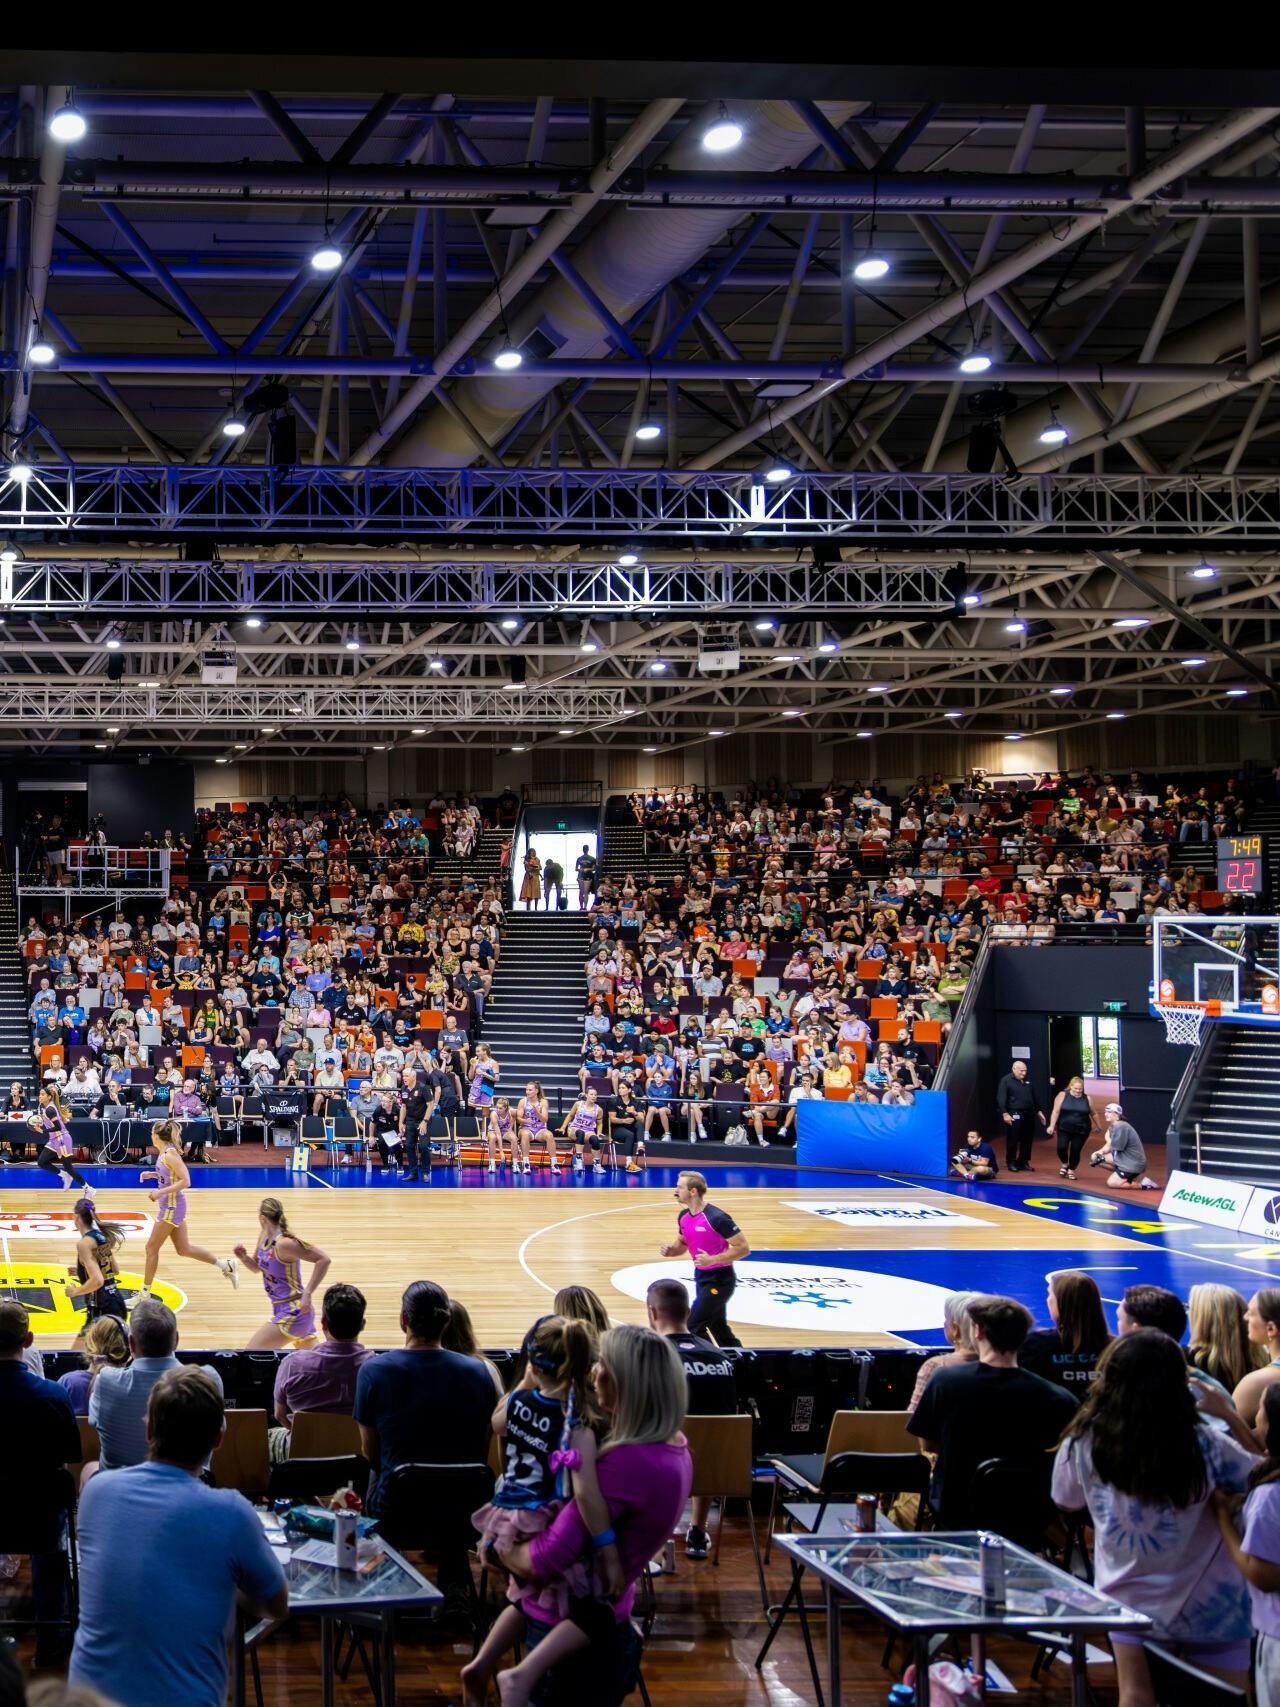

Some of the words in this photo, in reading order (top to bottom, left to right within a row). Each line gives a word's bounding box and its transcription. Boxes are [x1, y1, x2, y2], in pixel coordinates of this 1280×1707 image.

[1230, 837, 1261, 857] 7:49
[1227, 862, 1256, 889] 22
[269, 1105, 299, 1113] SPALDING
[1172, 1188, 1237, 1212] ActewAGL
[513, 1399, 551, 1433] TOLO
